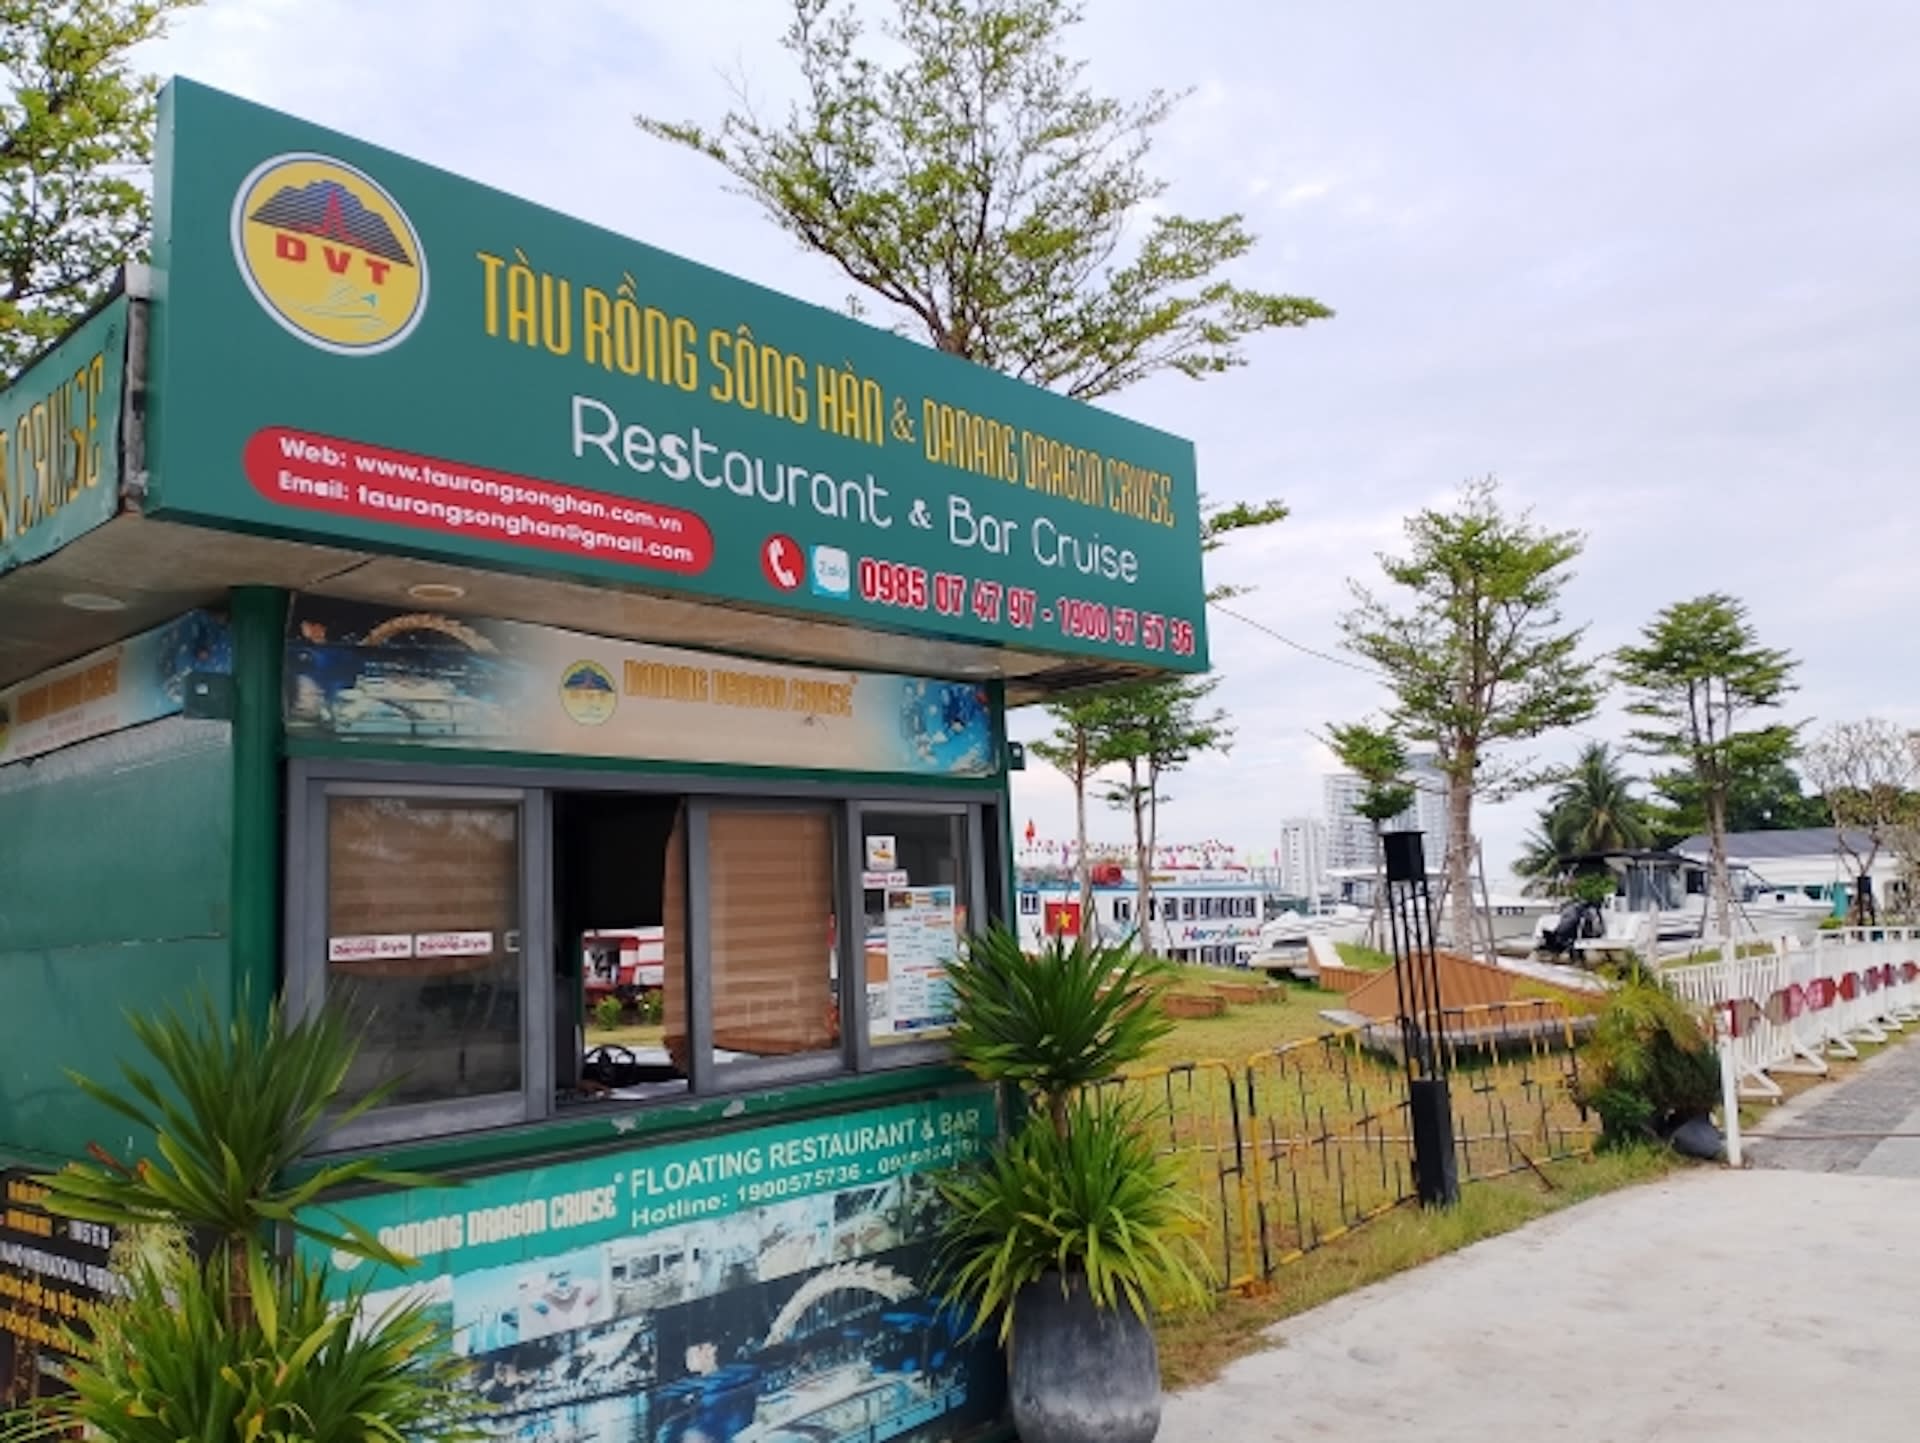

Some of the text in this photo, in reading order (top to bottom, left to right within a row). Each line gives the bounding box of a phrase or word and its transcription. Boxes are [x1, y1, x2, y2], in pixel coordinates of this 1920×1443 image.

[275, 232, 391, 285] DVT
[476, 247, 1175, 528] TÀU RỒNG SÔNG HÀN & DANANG DRAGON CRUISE
[278, 470, 694, 562] Email: taurongsonghan@gmail.com
[279, 436, 683, 532] Web: www.taurongsonghan.com.vn
[572, 394, 1139, 583] Restaurant & Bar Cruise
[858, 557, 928, 611] 0985
[933, 573, 966, 616] 07
[972, 578, 1003, 622] 47
[1007, 586, 1037, 630] 97
[1056, 597, 1112, 643] 1900
[1113, 606, 1138, 645] 57
[1141, 611, 1166, 651] 57
[1169, 618, 1195, 656] 36
[467, 1200, 547, 1246] DRAGON
[551, 1184, 616, 1229] CRUISE
[631, 1147, 763, 1199] FLOATING
[769, 1117, 916, 1171] RESTAURANT
[939, 1108, 979, 1137] BAR
[631, 1193, 729, 1229] Hotline:
[736, 1162, 861, 1203] 1900575736
